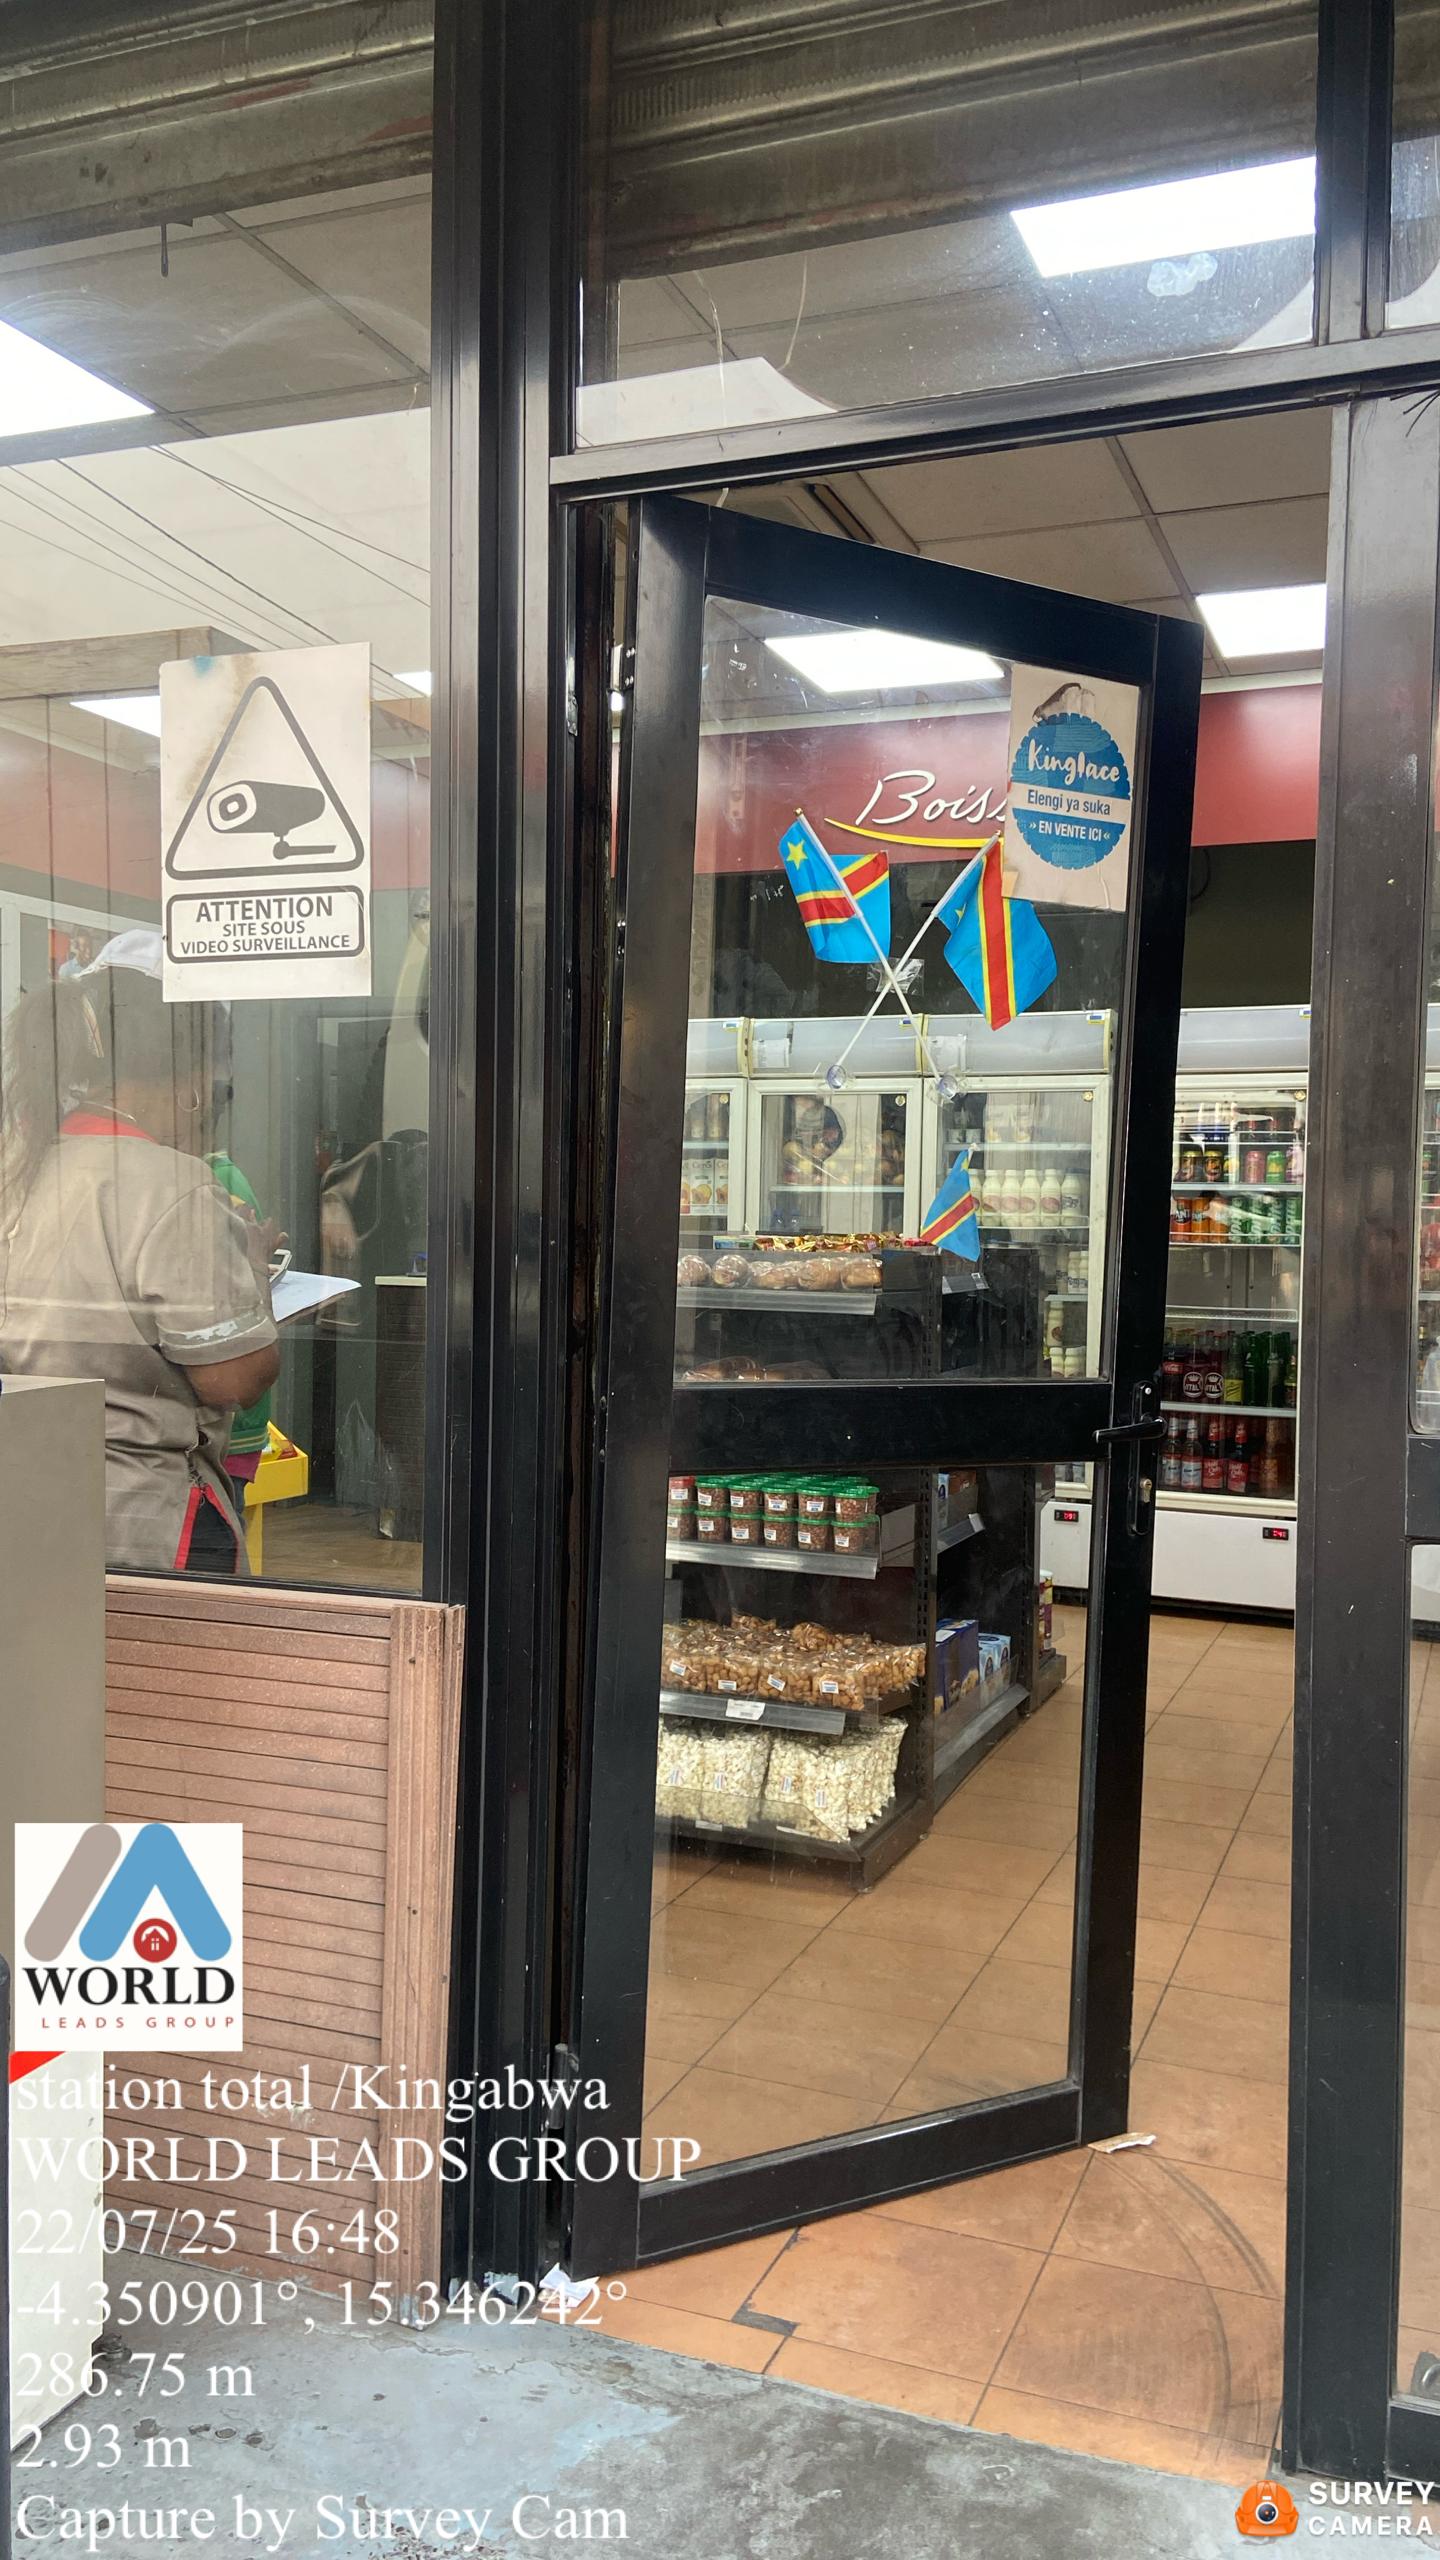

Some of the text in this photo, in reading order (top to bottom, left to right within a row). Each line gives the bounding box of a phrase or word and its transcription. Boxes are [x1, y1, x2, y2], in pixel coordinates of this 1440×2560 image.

[1027, 789, 1111, 816] Elengi ya suka
[1038, 820, 1102, 842] EN VENTE ICI
[196, 895, 333, 923] ATTENTION
[222, 920, 306, 938] SITE SOUS
[180, 934, 351, 955] VIDEO SURVEILLANCE
